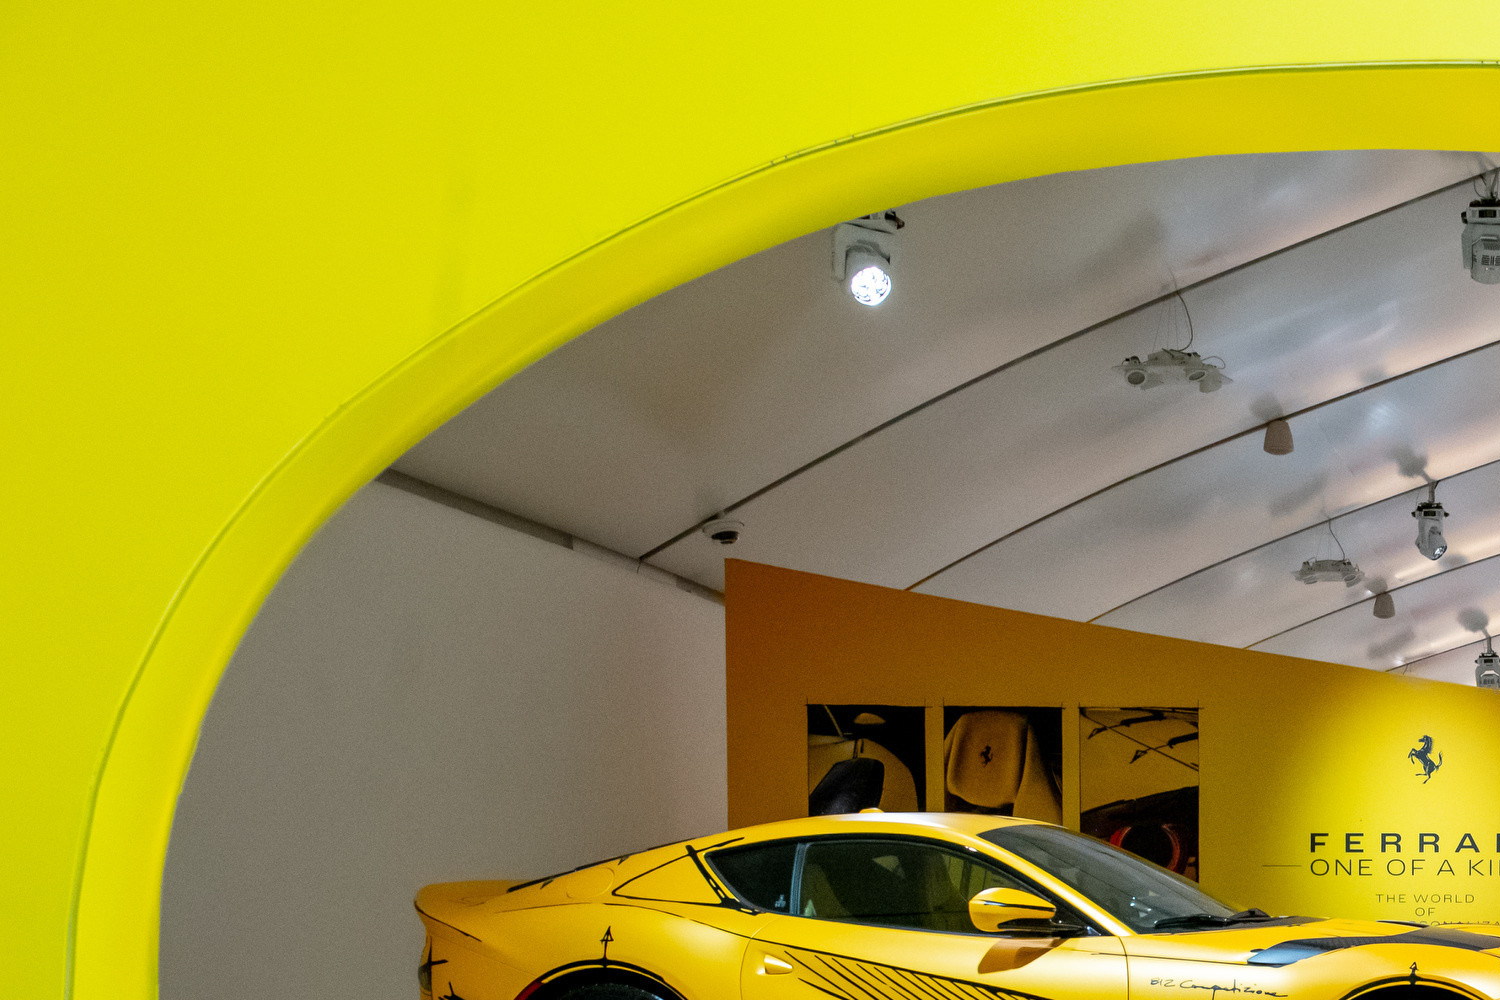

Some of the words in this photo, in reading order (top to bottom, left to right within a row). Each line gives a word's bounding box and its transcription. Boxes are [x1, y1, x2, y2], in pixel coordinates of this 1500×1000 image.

[1310, 858, 1373, 877] ONE
[1386, 858, 1426, 877] OF
[1436, 859, 1456, 877] A
[1375, 893, 1407, 904] THE
[1413, 893, 1476, 904] WORLD
[1414, 907, 1436, 917] OF
